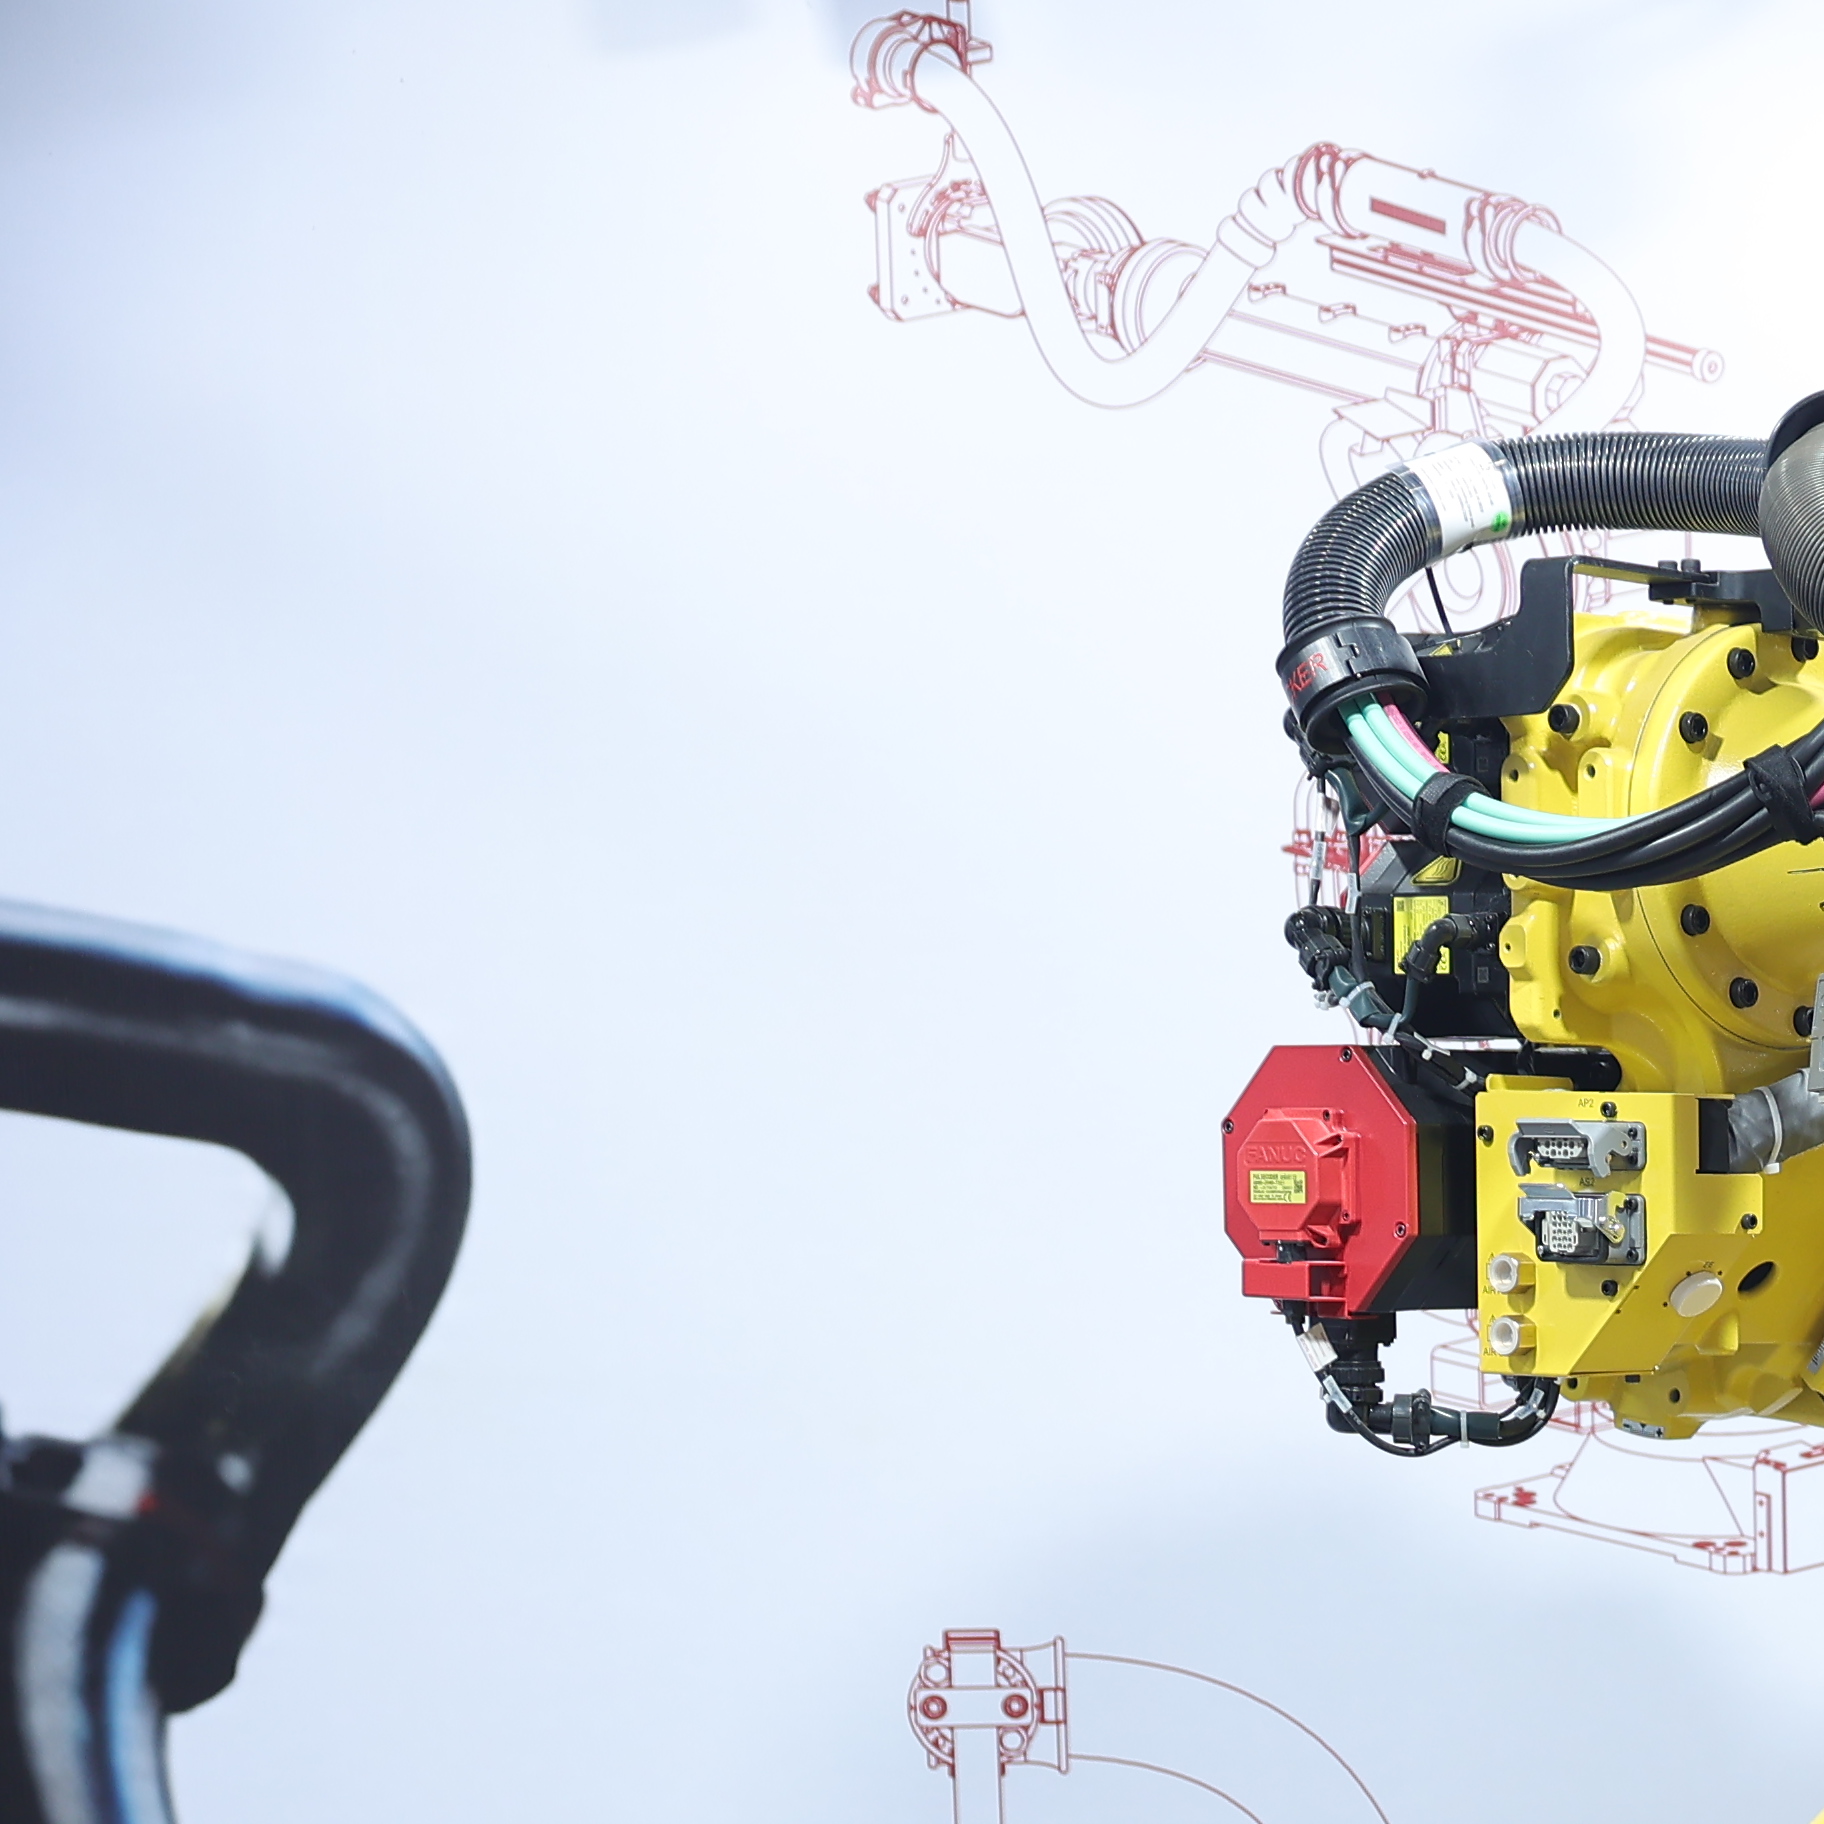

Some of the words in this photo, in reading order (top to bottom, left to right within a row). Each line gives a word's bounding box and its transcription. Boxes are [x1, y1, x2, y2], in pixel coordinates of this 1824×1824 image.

[1287, 652, 1328, 701] KER
[1577, 1098, 1594, 1108] AP2
[1245, 1145, 1307, 1163] FANUC
[1579, 1177, 1596, 1187] AS2
